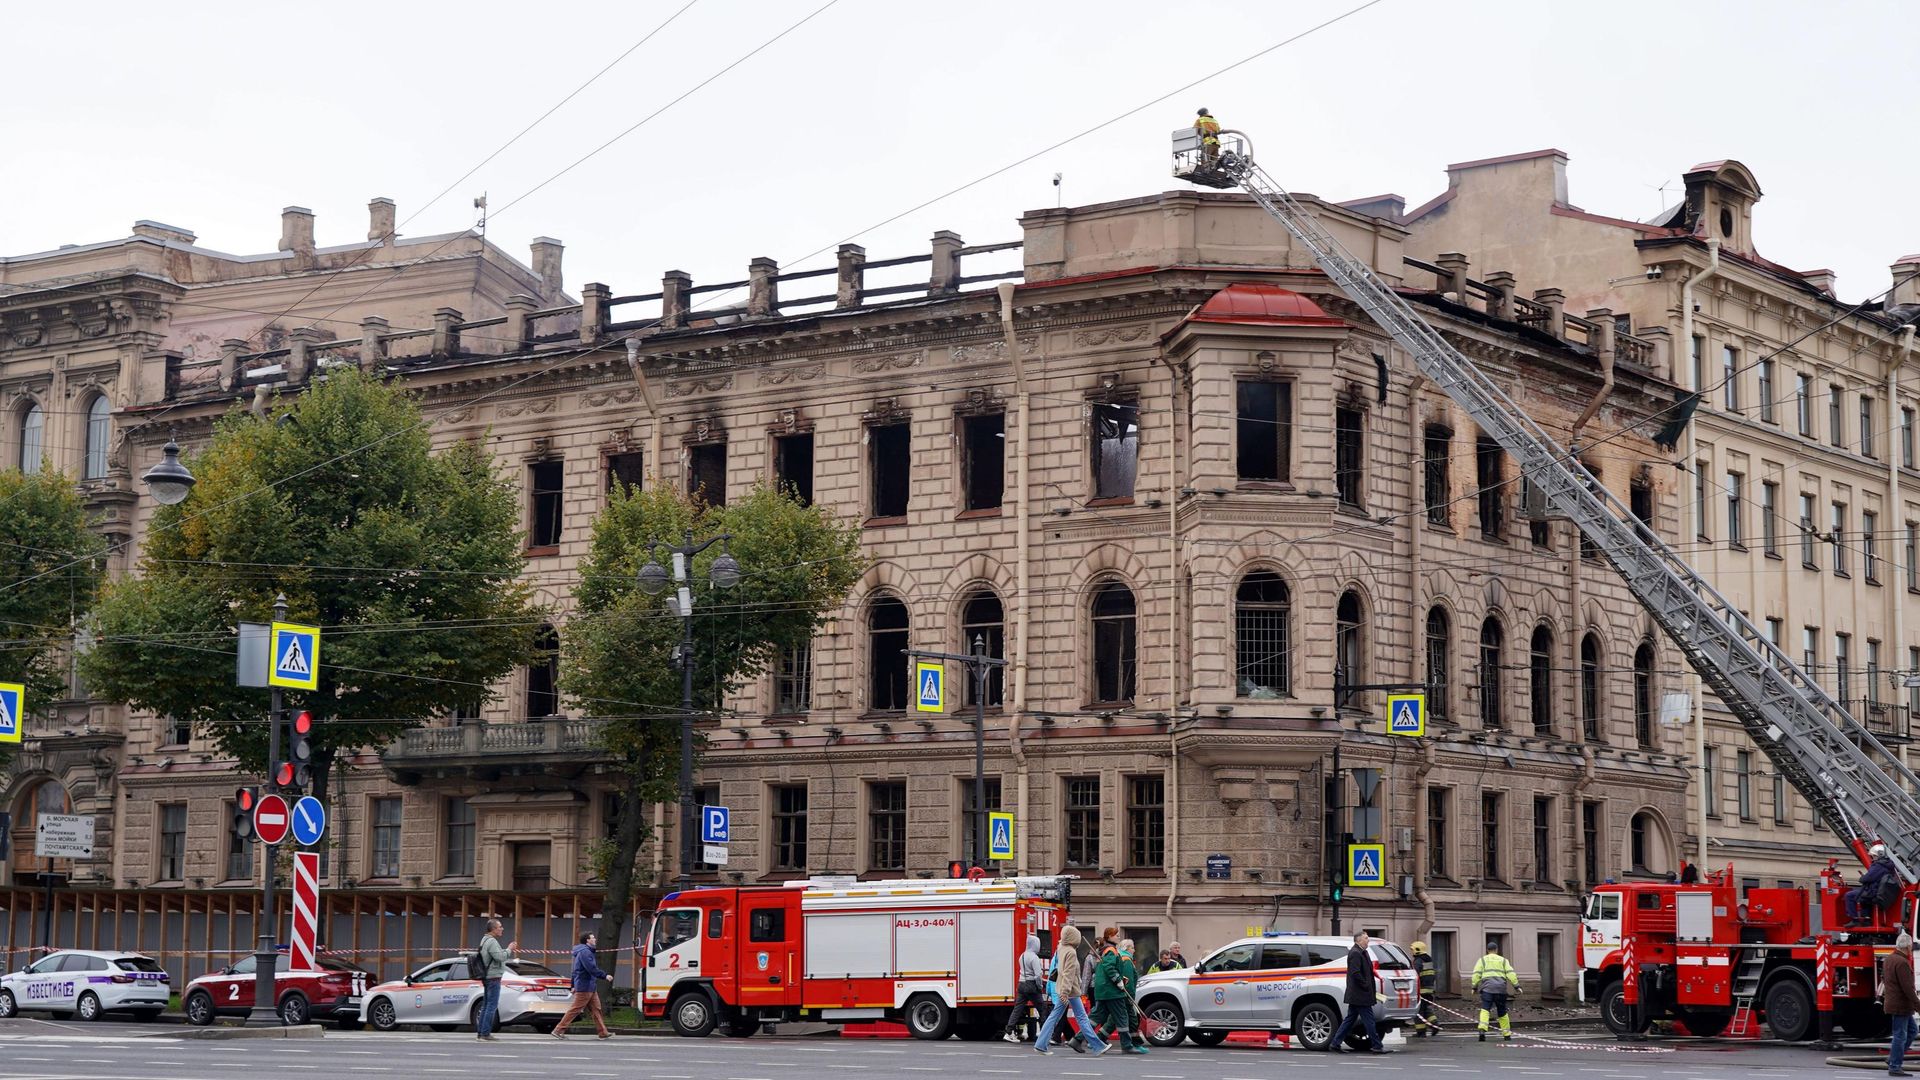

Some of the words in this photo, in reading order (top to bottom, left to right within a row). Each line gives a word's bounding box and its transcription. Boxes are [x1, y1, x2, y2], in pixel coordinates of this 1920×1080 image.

[710, 810, 725, 838] P
[896, 918, 955, 928] АЦ-3,0-40/4
[1052, 914, 1057, 926] 2
[1590, 932, 1604, 944] 53
[669, 953, 680, 968] 2
[27, 982, 63, 999] ИЗВЕСТИЯ
[228, 984, 240, 1000] 2
[1256, 984, 1272, 992] МЧС
[1273, 983, 1302, 991] РОССИИ
